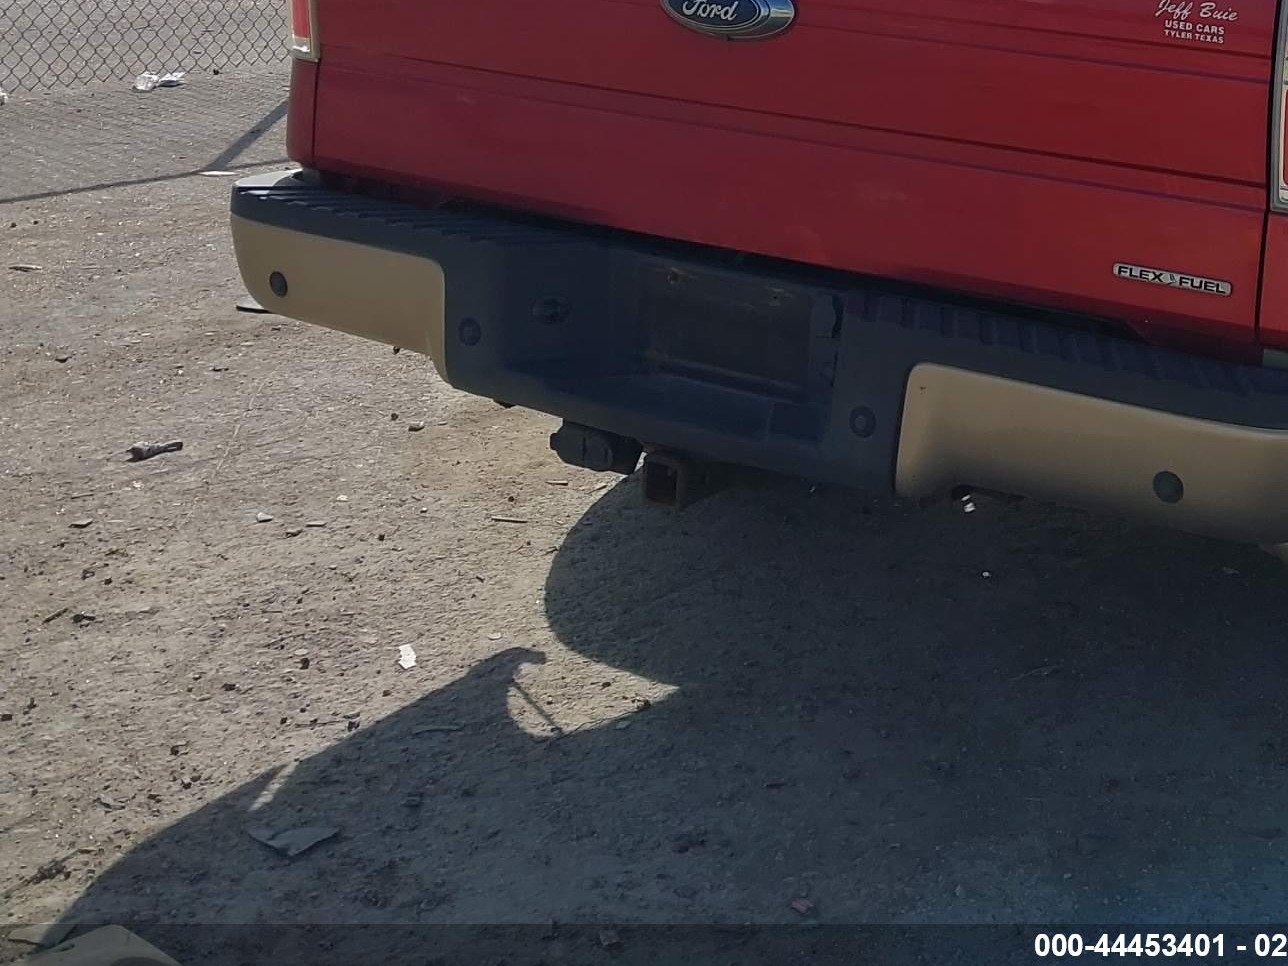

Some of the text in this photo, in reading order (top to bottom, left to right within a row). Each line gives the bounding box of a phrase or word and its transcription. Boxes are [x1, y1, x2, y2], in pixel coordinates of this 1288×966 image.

[1200, 2, 1238, 21] Buie
[1165, 19, 1225, 35] USED CARS
[1164, 29, 1224, 44] TYLER TEXAS
[1118, 265, 1226, 294] FLEX FUEL
